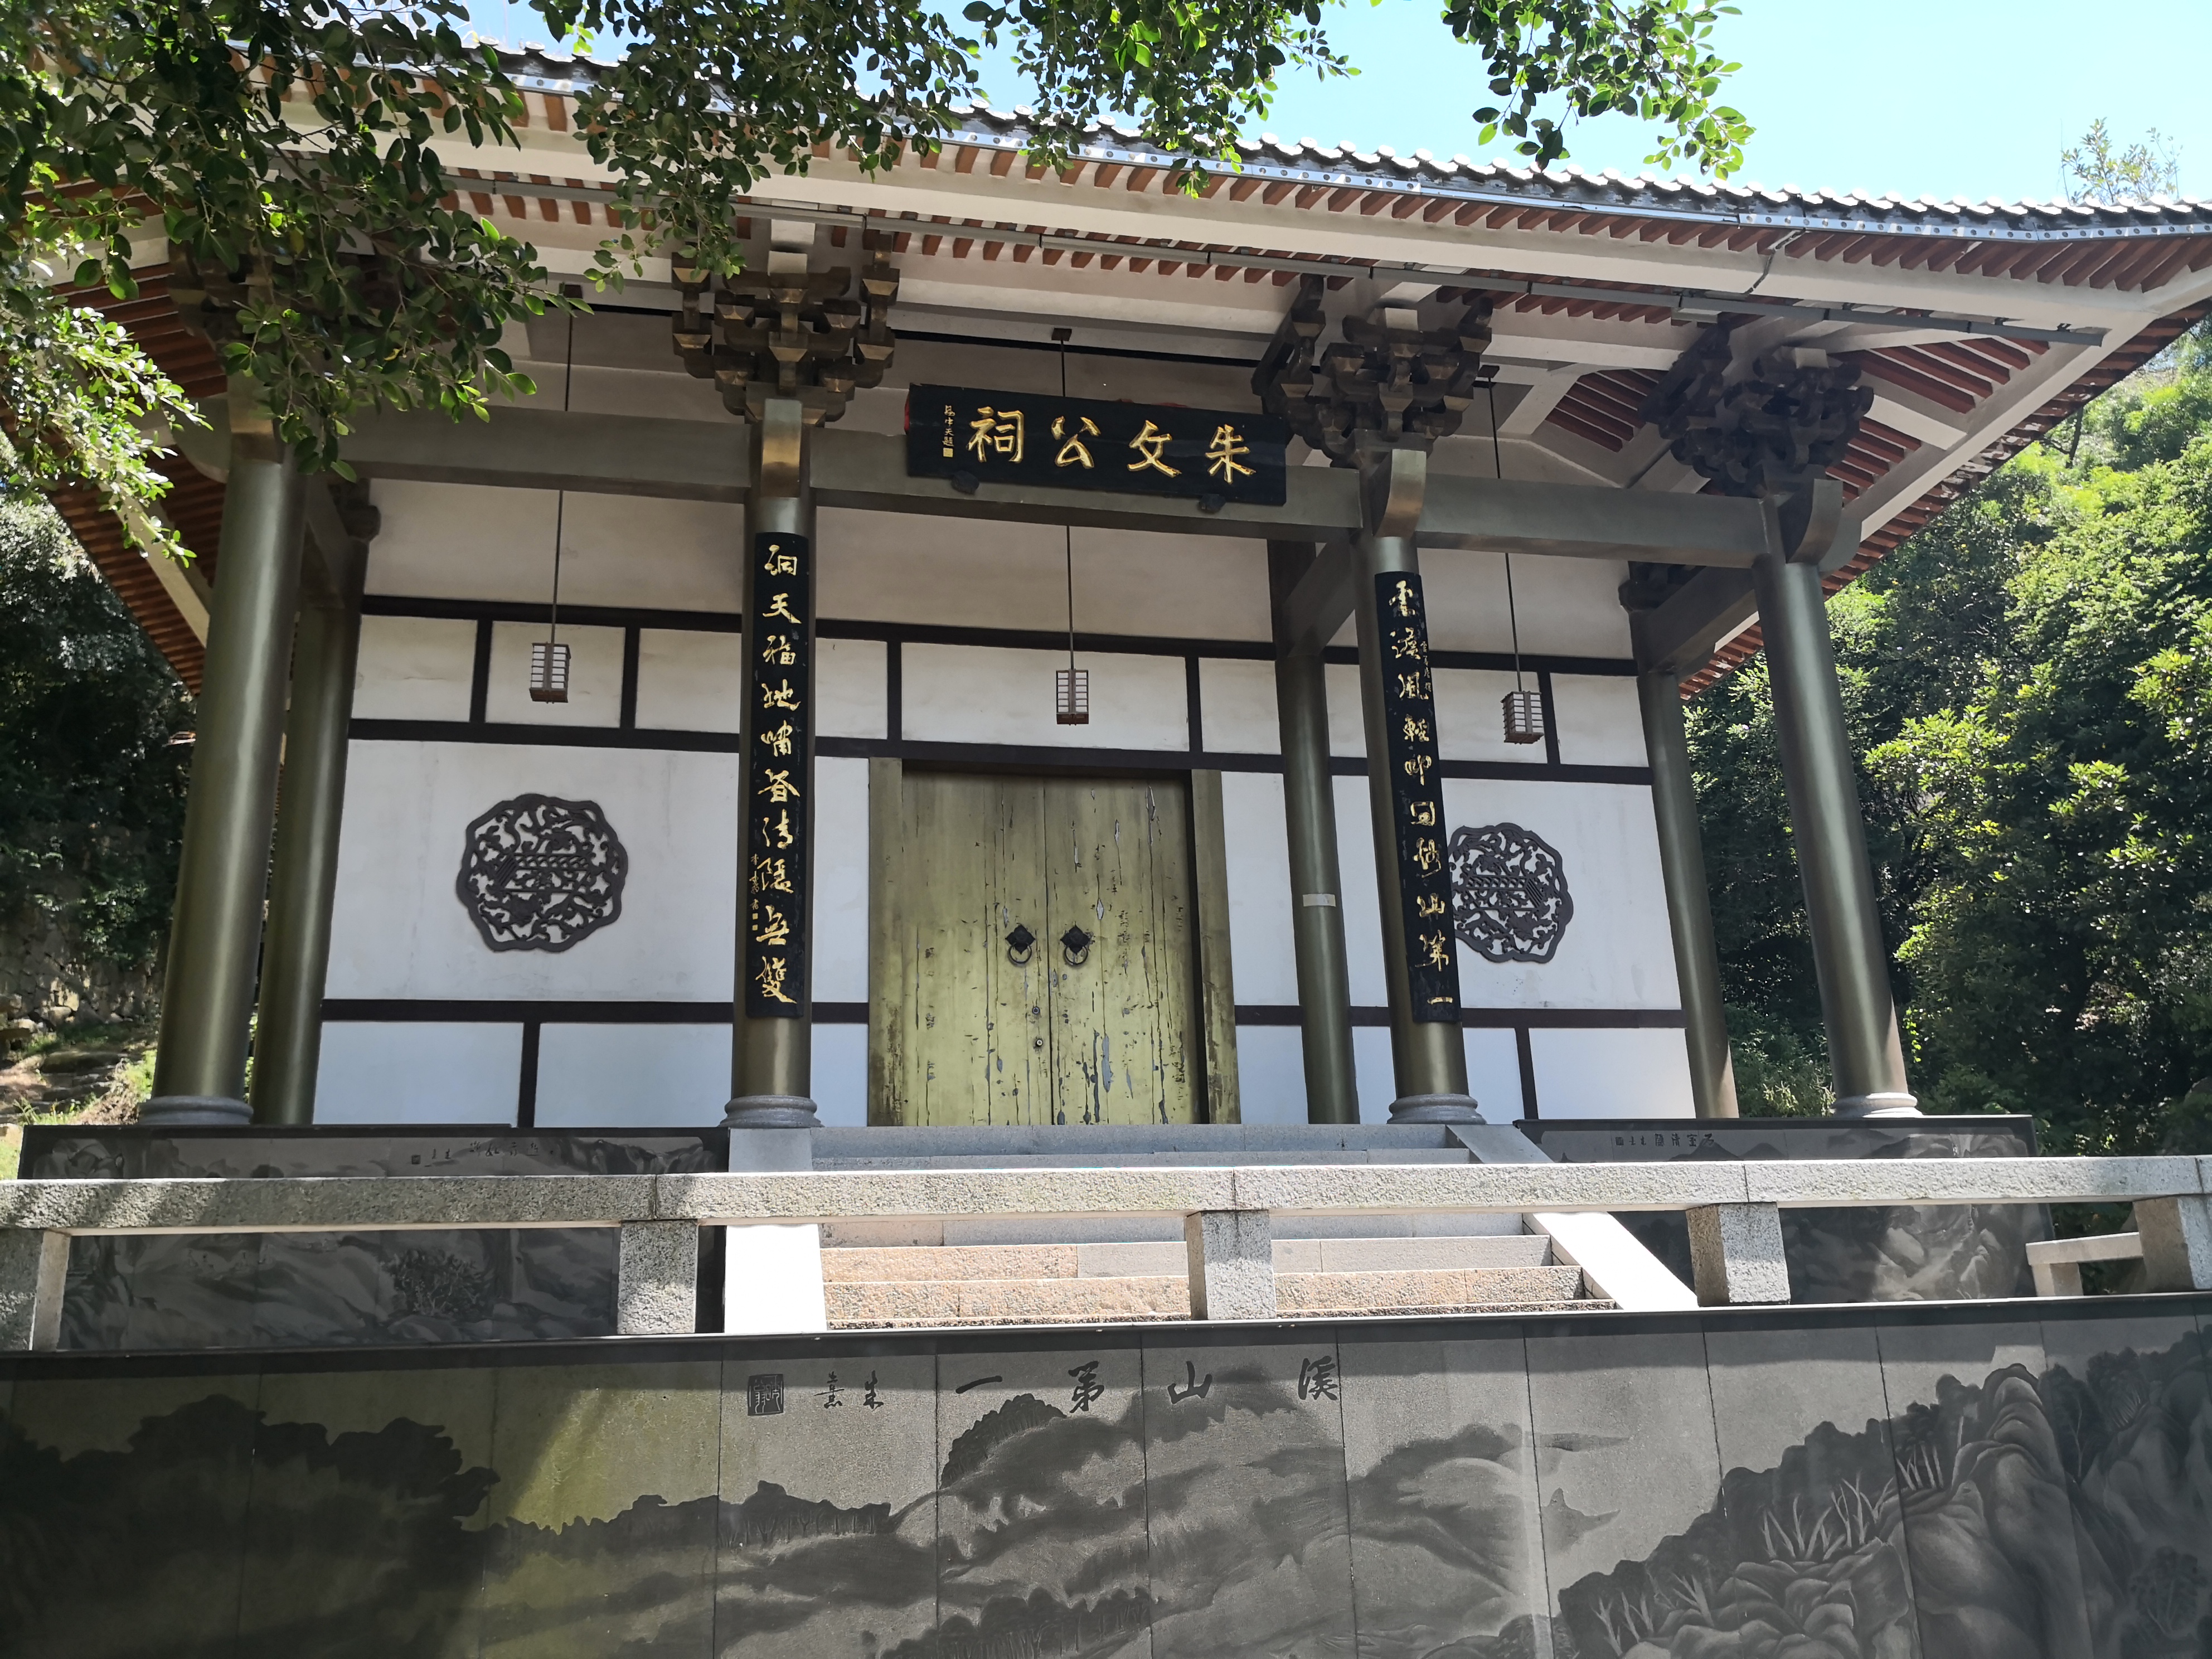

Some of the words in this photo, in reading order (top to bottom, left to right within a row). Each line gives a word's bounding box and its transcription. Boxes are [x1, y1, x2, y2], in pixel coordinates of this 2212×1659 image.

[966, 406, 1257, 484] 朱文公祠
[813, 1370, 884, 1410] 朱熹
[955, 1355, 1338, 1414] 溪山第一
